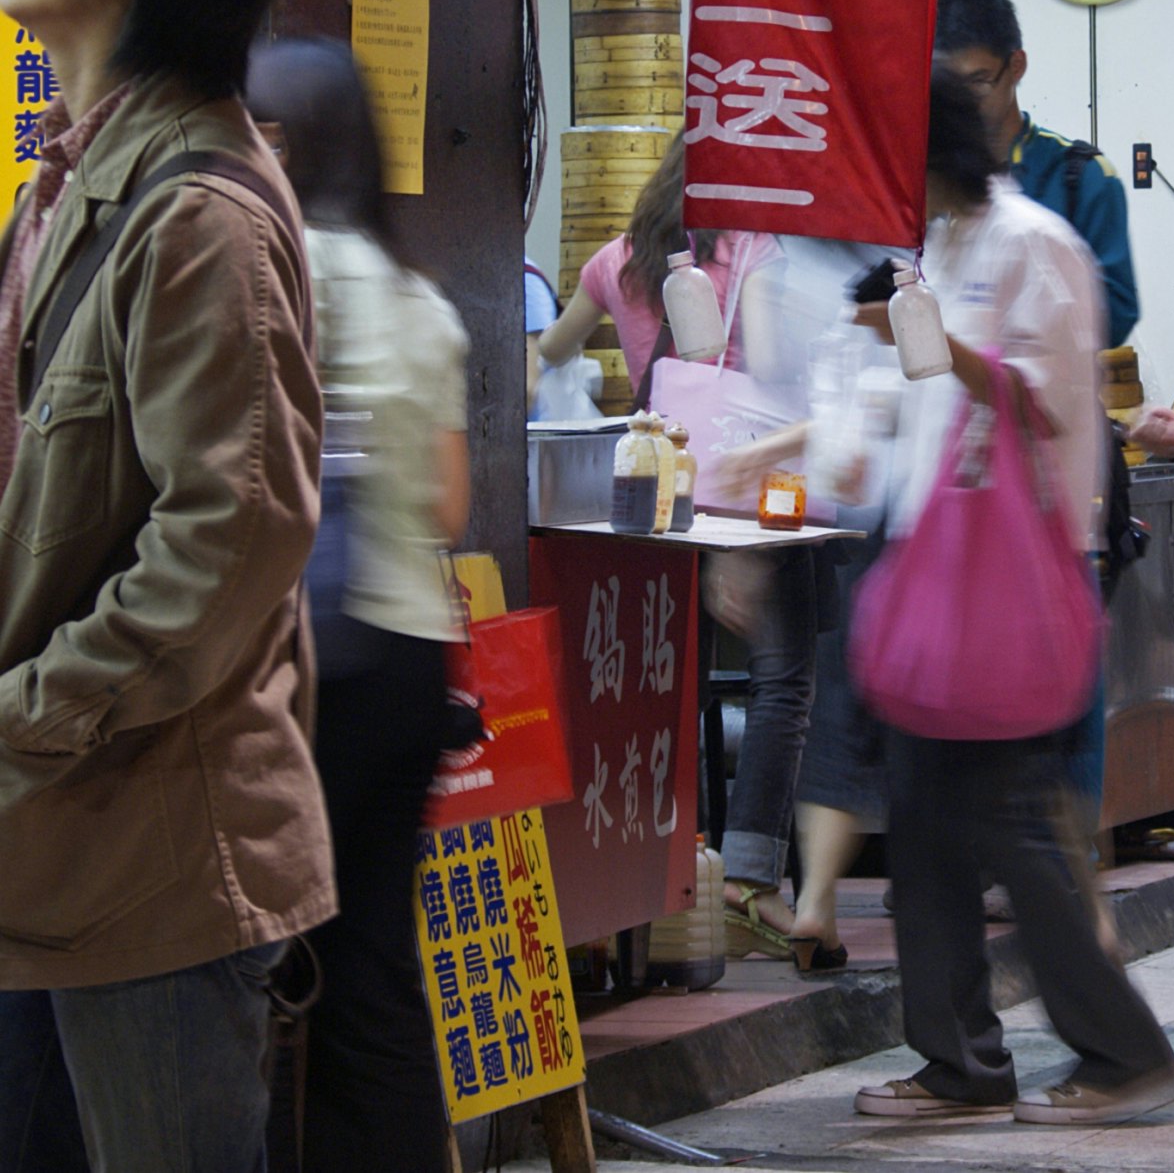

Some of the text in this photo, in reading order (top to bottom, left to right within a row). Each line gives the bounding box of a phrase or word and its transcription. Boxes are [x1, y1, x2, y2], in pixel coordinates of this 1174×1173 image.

[582, 572, 676, 704] 鍋貼
[582, 727, 678, 850] 水煎包
